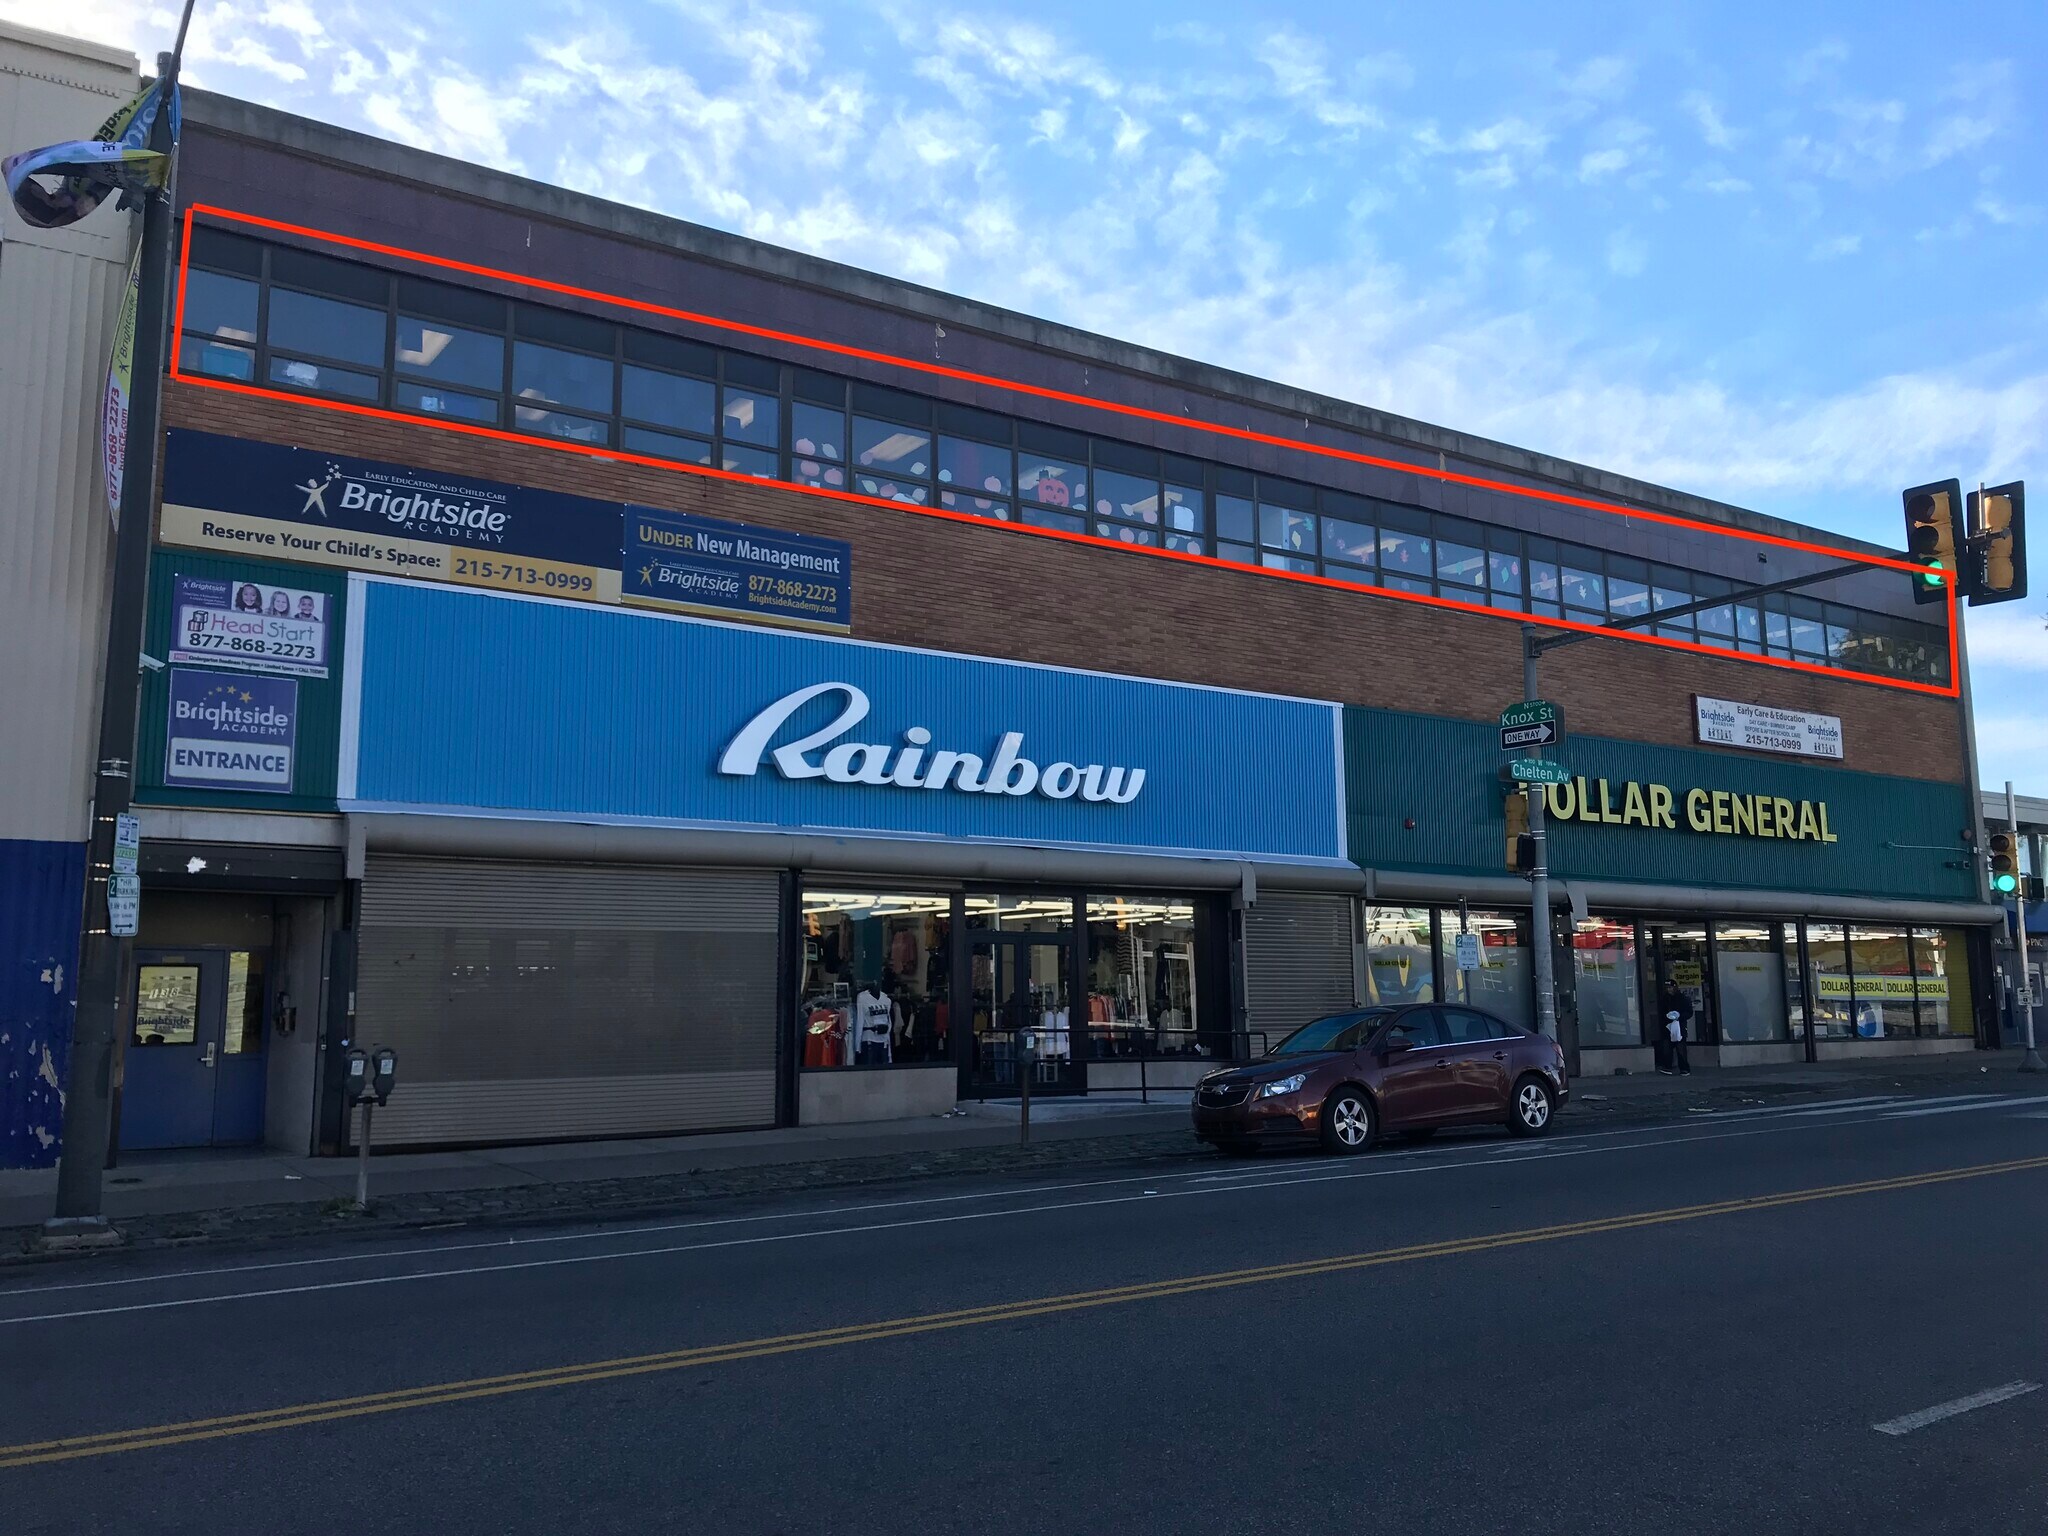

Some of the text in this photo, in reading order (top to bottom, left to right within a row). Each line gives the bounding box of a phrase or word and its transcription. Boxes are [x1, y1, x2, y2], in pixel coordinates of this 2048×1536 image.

[119, 294, 135, 358] Brightside
[110, 387, 121, 500] 877-868-2273
[365, 471, 507, 501] EARLY EDUCATION AND CHILD CARE
[339, 482, 507, 532] Brightside
[403, 521, 504, 544] ACADEMY
[202, 521, 593, 592] Reserve Your Child's Space: 215-713-0999
[639, 524, 840, 574] UNDER New Management
[190, 581, 226, 591] Brightside
[658, 567, 739, 593] Brightside
[748, 575, 837, 603] 877-868-2273
[688, 588, 739, 599] ACADEMY
[748, 592, 837, 614] BrightsideAcademy.com
[210, 613, 315, 641] Head Start
[189, 633, 315, 659] 877-868-2273
[176, 700, 288, 730] Brightside
[1502, 707, 1553, 726] Knox St
[1701, 709, 1735, 725] Brightside
[1737, 706, 1806, 723] Early Care & Education
[222, 724, 287, 736] ACADEMY
[1507, 730, 1540, 743] ONE WAY
[1746, 733, 1801, 750] 215-713-0999
[1808, 724, 1839, 740] Brightside
[717, 681, 1147, 804] Rainbow
[175, 749, 285, 772] ENTRANCE
[1512, 764, 1569, 782] Chelten Av
[1687, 788, 1837, 842] GENERAL
[110, 880, 116, 895] 2
[1456, 936, 1462, 946] 2
[1821, 980, 1946, 993] DOLLAR GENERAL DOLLAR GENERAL
